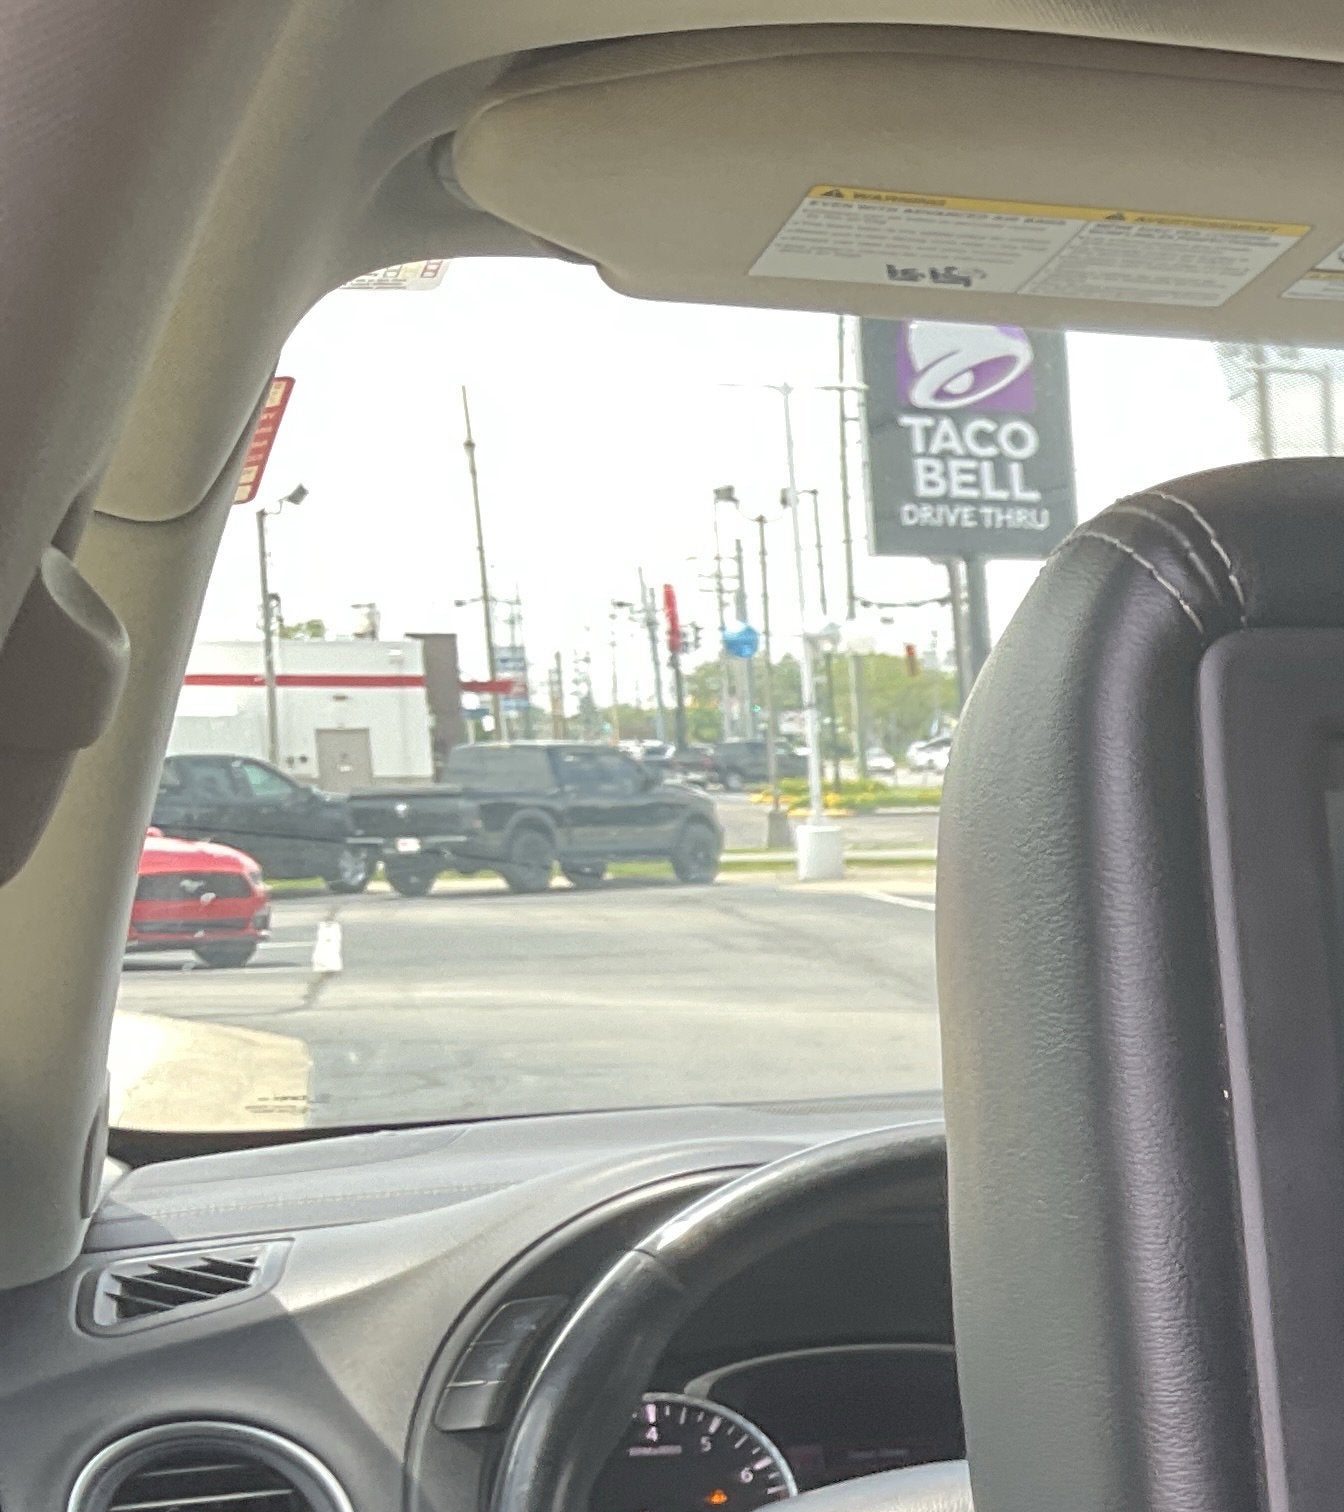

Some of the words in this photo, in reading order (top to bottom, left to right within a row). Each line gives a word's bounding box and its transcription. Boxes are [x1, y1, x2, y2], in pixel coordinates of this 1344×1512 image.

[898, 415, 1039, 459] TACO
[914, 458, 1042, 502] BELL
[901, 503, 978, 529] DRIVE
[979, 506, 1050, 531] THRU
[700, 1435, 712, 1452] 5
[740, 1466, 754, 1483] 6
